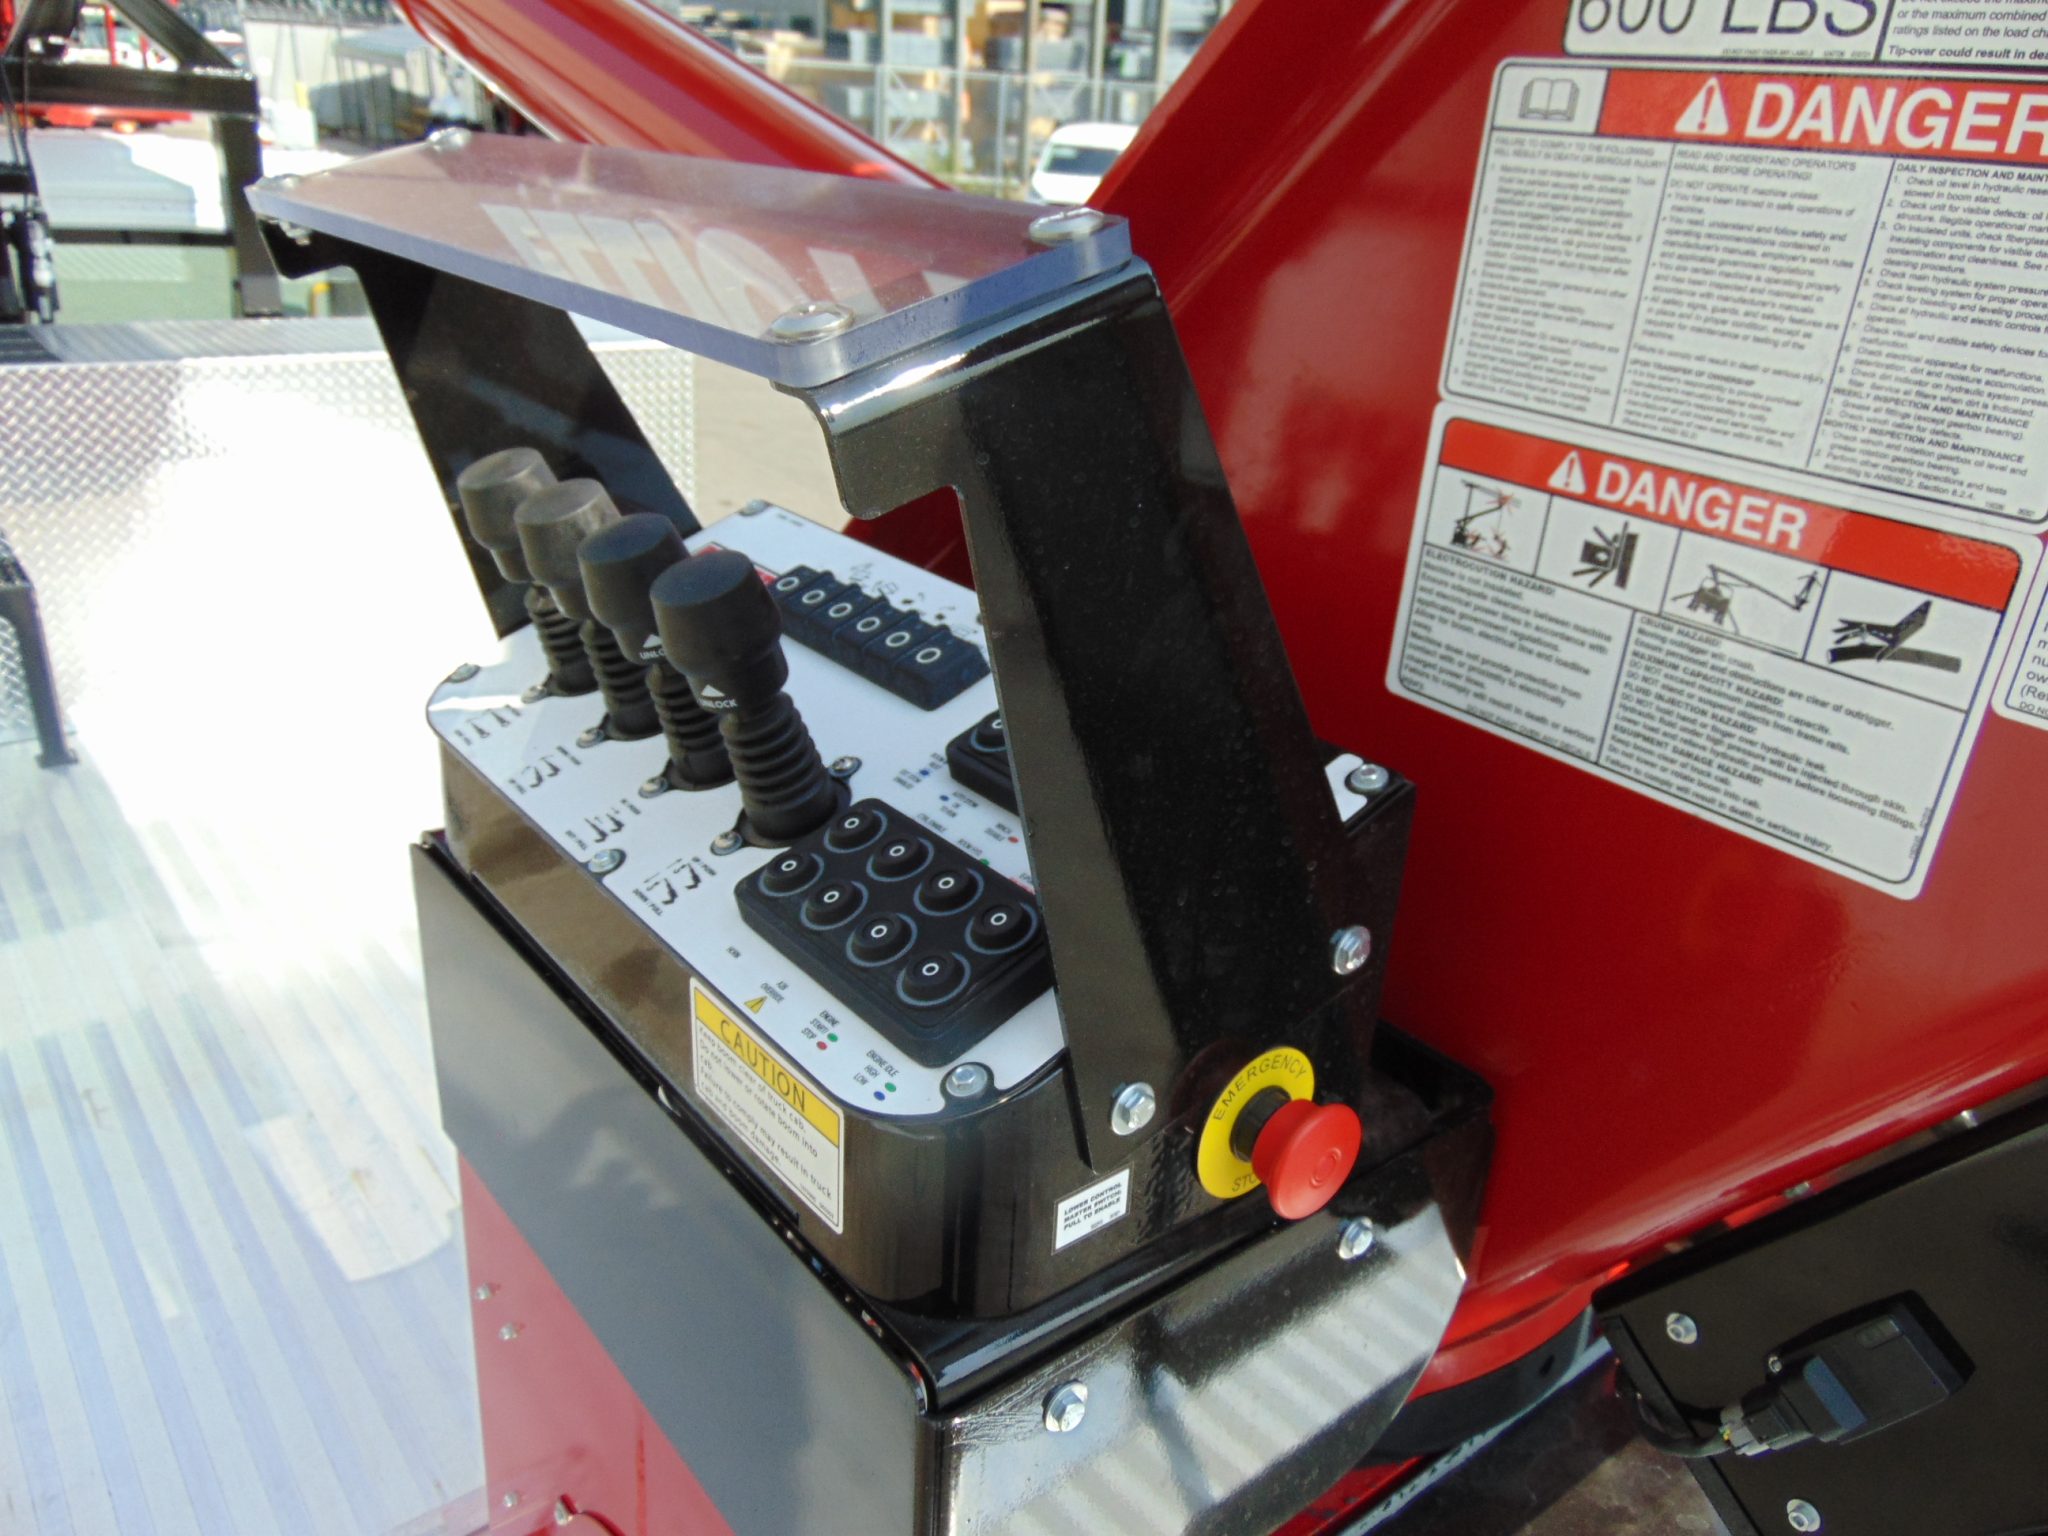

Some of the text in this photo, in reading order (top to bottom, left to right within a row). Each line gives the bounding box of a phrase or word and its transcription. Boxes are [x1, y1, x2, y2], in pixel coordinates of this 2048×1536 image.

[1578, 0, 1877, 37] 600 LBS
[1897, 9, 2048, 21] or the maximum combined
[1893, 25, 2029, 38] ratings listed on the load
[1888, 45, 1936, 57] Tip-over
[1939, 46, 1972, 57] could
[1976, 46, 2010, 59] result
[2013, 48, 2025, 59] in
[1744, 83, 2048, 157] DANGER
[1712, 164, 1749, 175] BEFORE
[1725, 153, 1790, 165] UNDERSTAND
[1895, 164, 2014, 179] DAILY INSPECTION AND
[1906, 176, 1933, 185] Check
[1949, 180, 1970, 188] level
[1972, 181, 1980, 189] in
[1981, 182, 2025, 195] hydraulic
[1946, 192, 1972, 201] boom
[1899, 200, 1926, 209] Check
[1947, 204, 1959, 212] for
[1962, 206, 1990, 215] visible
[2031, 211, 2043, 219] oil
[1882, 258, 1918, 269] cleaning
[1948, 253, 2042, 269] and See
[1879, 269, 2006, 292] Check main hydraulic system
[1939, 288, 2018, 306] system for proper
[1958, 302, 2013, 317] and leveling
[1951, 314, 2041, 332] and electric controls
[1936, 335, 2035, 356] audible safety devices
[1872, 394, 2029, 428] INSPECTION AND MAINTENANCE
[1946, 419, 1982, 434] gearbox
[1868, 427, 1925, 443] INSPECTION
[1927, 438, 1948, 448] AND
[1950, 443, 2024, 463] MAINTENANCE
[1596, 461, 1808, 550] DANGER
[640, 648, 665, 660] UNLO
[1631, 649, 1679, 671] MAXIMUM
[1682, 666, 1733, 689] CAPACITY
[1654, 692, 1707, 716] INJECTION
[1788, 690, 1803, 699] are
[1805, 694, 1830, 708] clear
[1831, 702, 1843, 712] of
[1843, 706, 1895, 732] outrigger.
[1772, 721, 1794, 734] from
[1796, 729, 1824, 744] frame
[1760, 741, 1803, 765] hydraulic
[1768, 756, 1908, 812] will be injected through skin.
[1752, 764, 1918, 831] pressure before loosening fittings.
[819, 1010, 840, 1027] ENGINE
[801, 1027, 817, 1040] STOP
[720, 1019, 806, 1113] CAUTION
[866, 1050, 899, 1078] ENGINE IDLE
[853, 1072, 869, 1086] LOW
[1213, 1053, 1307, 1121] EMERGENCY
[768, 1091, 787, 1112] truck
[789, 1111, 806, 1132] cab.
[754, 1092, 776, 1117] rotate
[778, 1115, 800, 1141] boom
[802, 1139, 818, 1158] into
[760, 1126, 775, 1147] may
[777, 1142, 799, 1169] result
[801, 1165, 809, 1178] in
[810, 1174, 832, 1199] truck
[1232, 1173, 1258, 1193] STO
[1065, 1183, 1121, 1215] LOWER CONTROL
[1064, 1205, 1091, 1223] MASTER
[1064, 1218, 1081, 1231] PULL
[1084, 1212, 1092, 1220] TO
[1095, 1197, 1120, 1215] ENABLE
